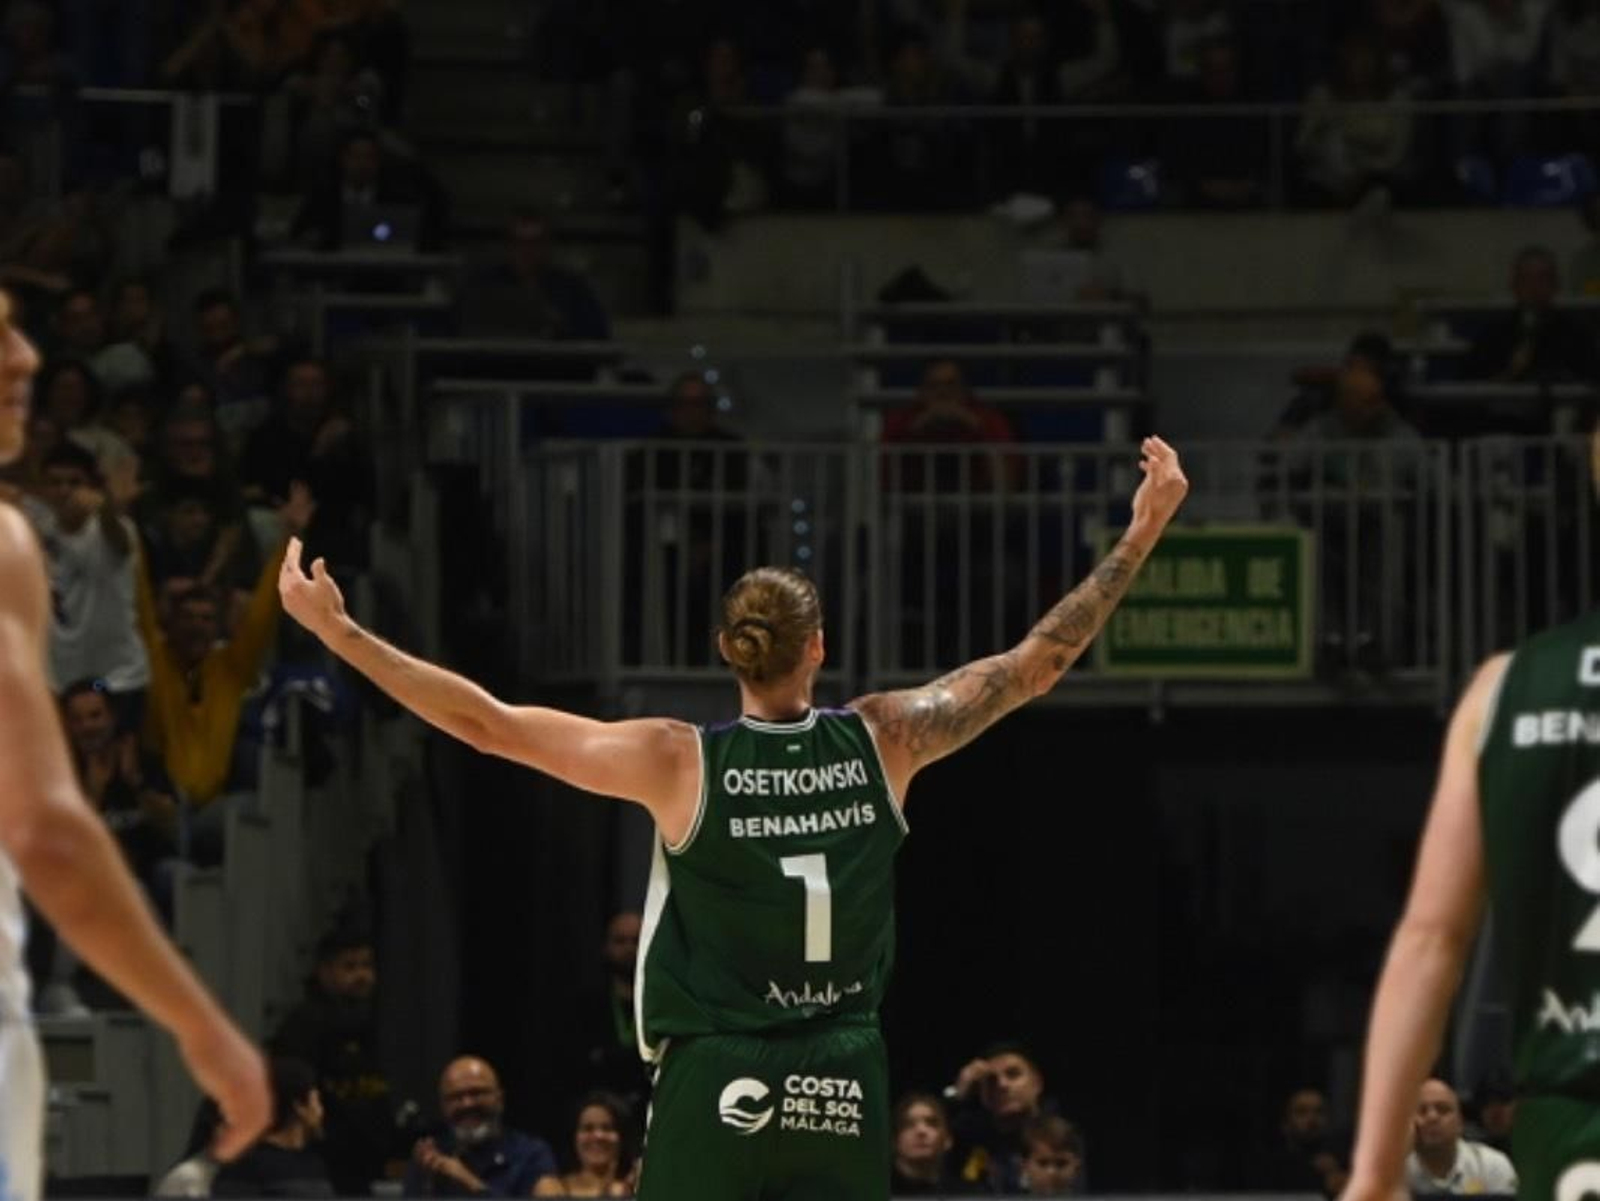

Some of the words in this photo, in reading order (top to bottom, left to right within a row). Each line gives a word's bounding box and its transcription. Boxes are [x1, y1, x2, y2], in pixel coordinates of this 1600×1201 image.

[723, 758, 868, 796] OSETKOWSKI
[729, 801, 876, 838] BENAHAVÍS
[779, 853, 832, 962] 1
[784, 1074, 863, 1100] COSTA
[783, 1098, 821, 1115] DEL
[825, 1101, 862, 1120] SOL
